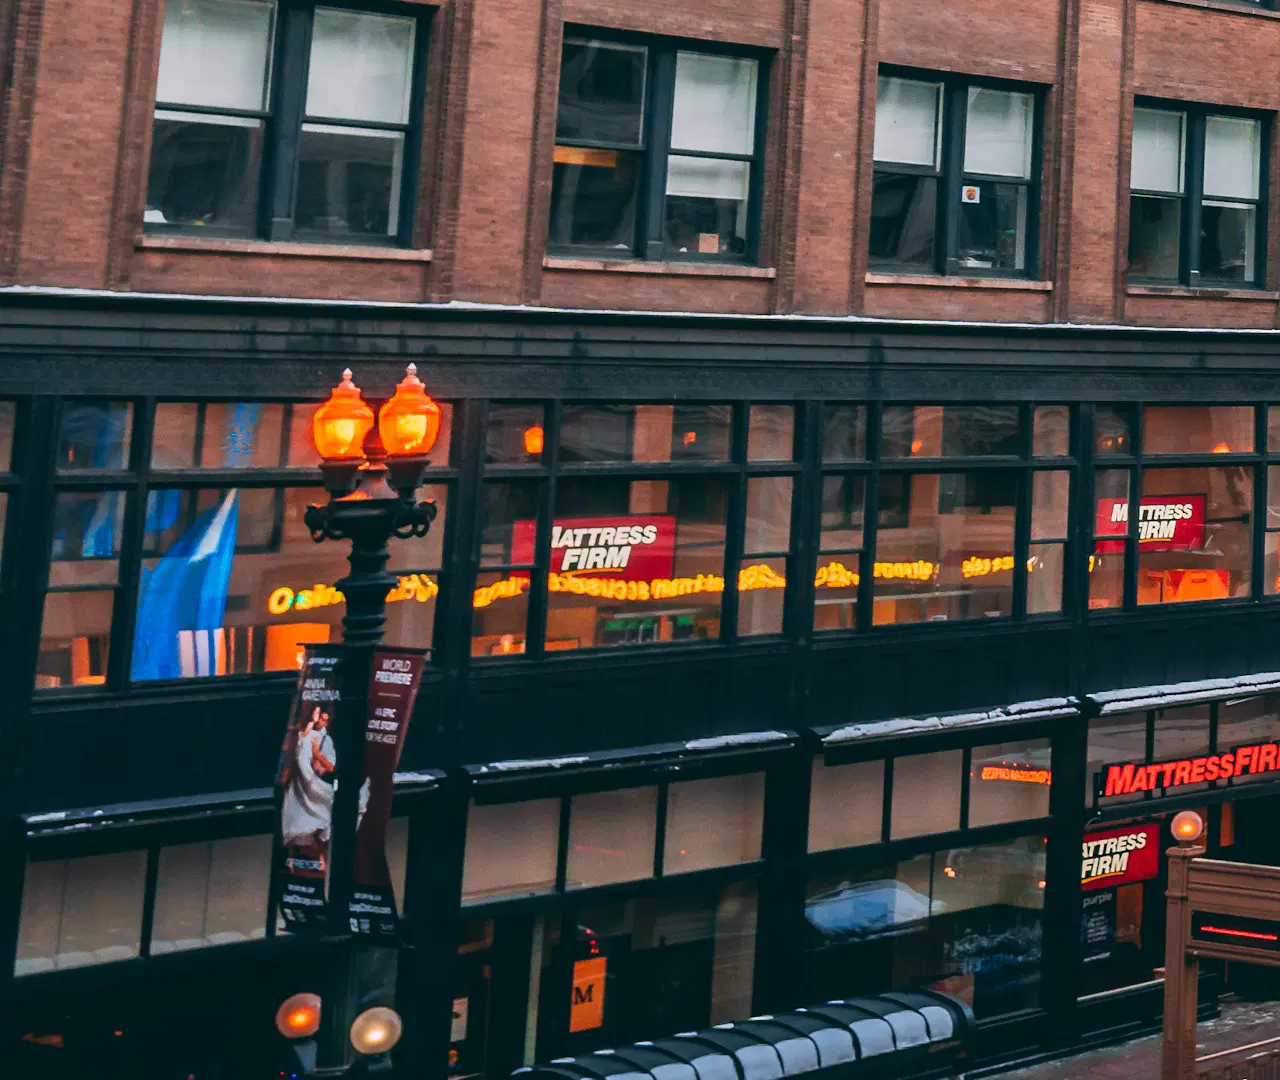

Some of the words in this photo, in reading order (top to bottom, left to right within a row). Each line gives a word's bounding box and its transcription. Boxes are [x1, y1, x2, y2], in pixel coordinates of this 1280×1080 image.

[1111, 503, 1193, 522] MTTRESS
[561, 546, 631, 571] FIRM
[1081, 852, 1129, 879] FIRM
